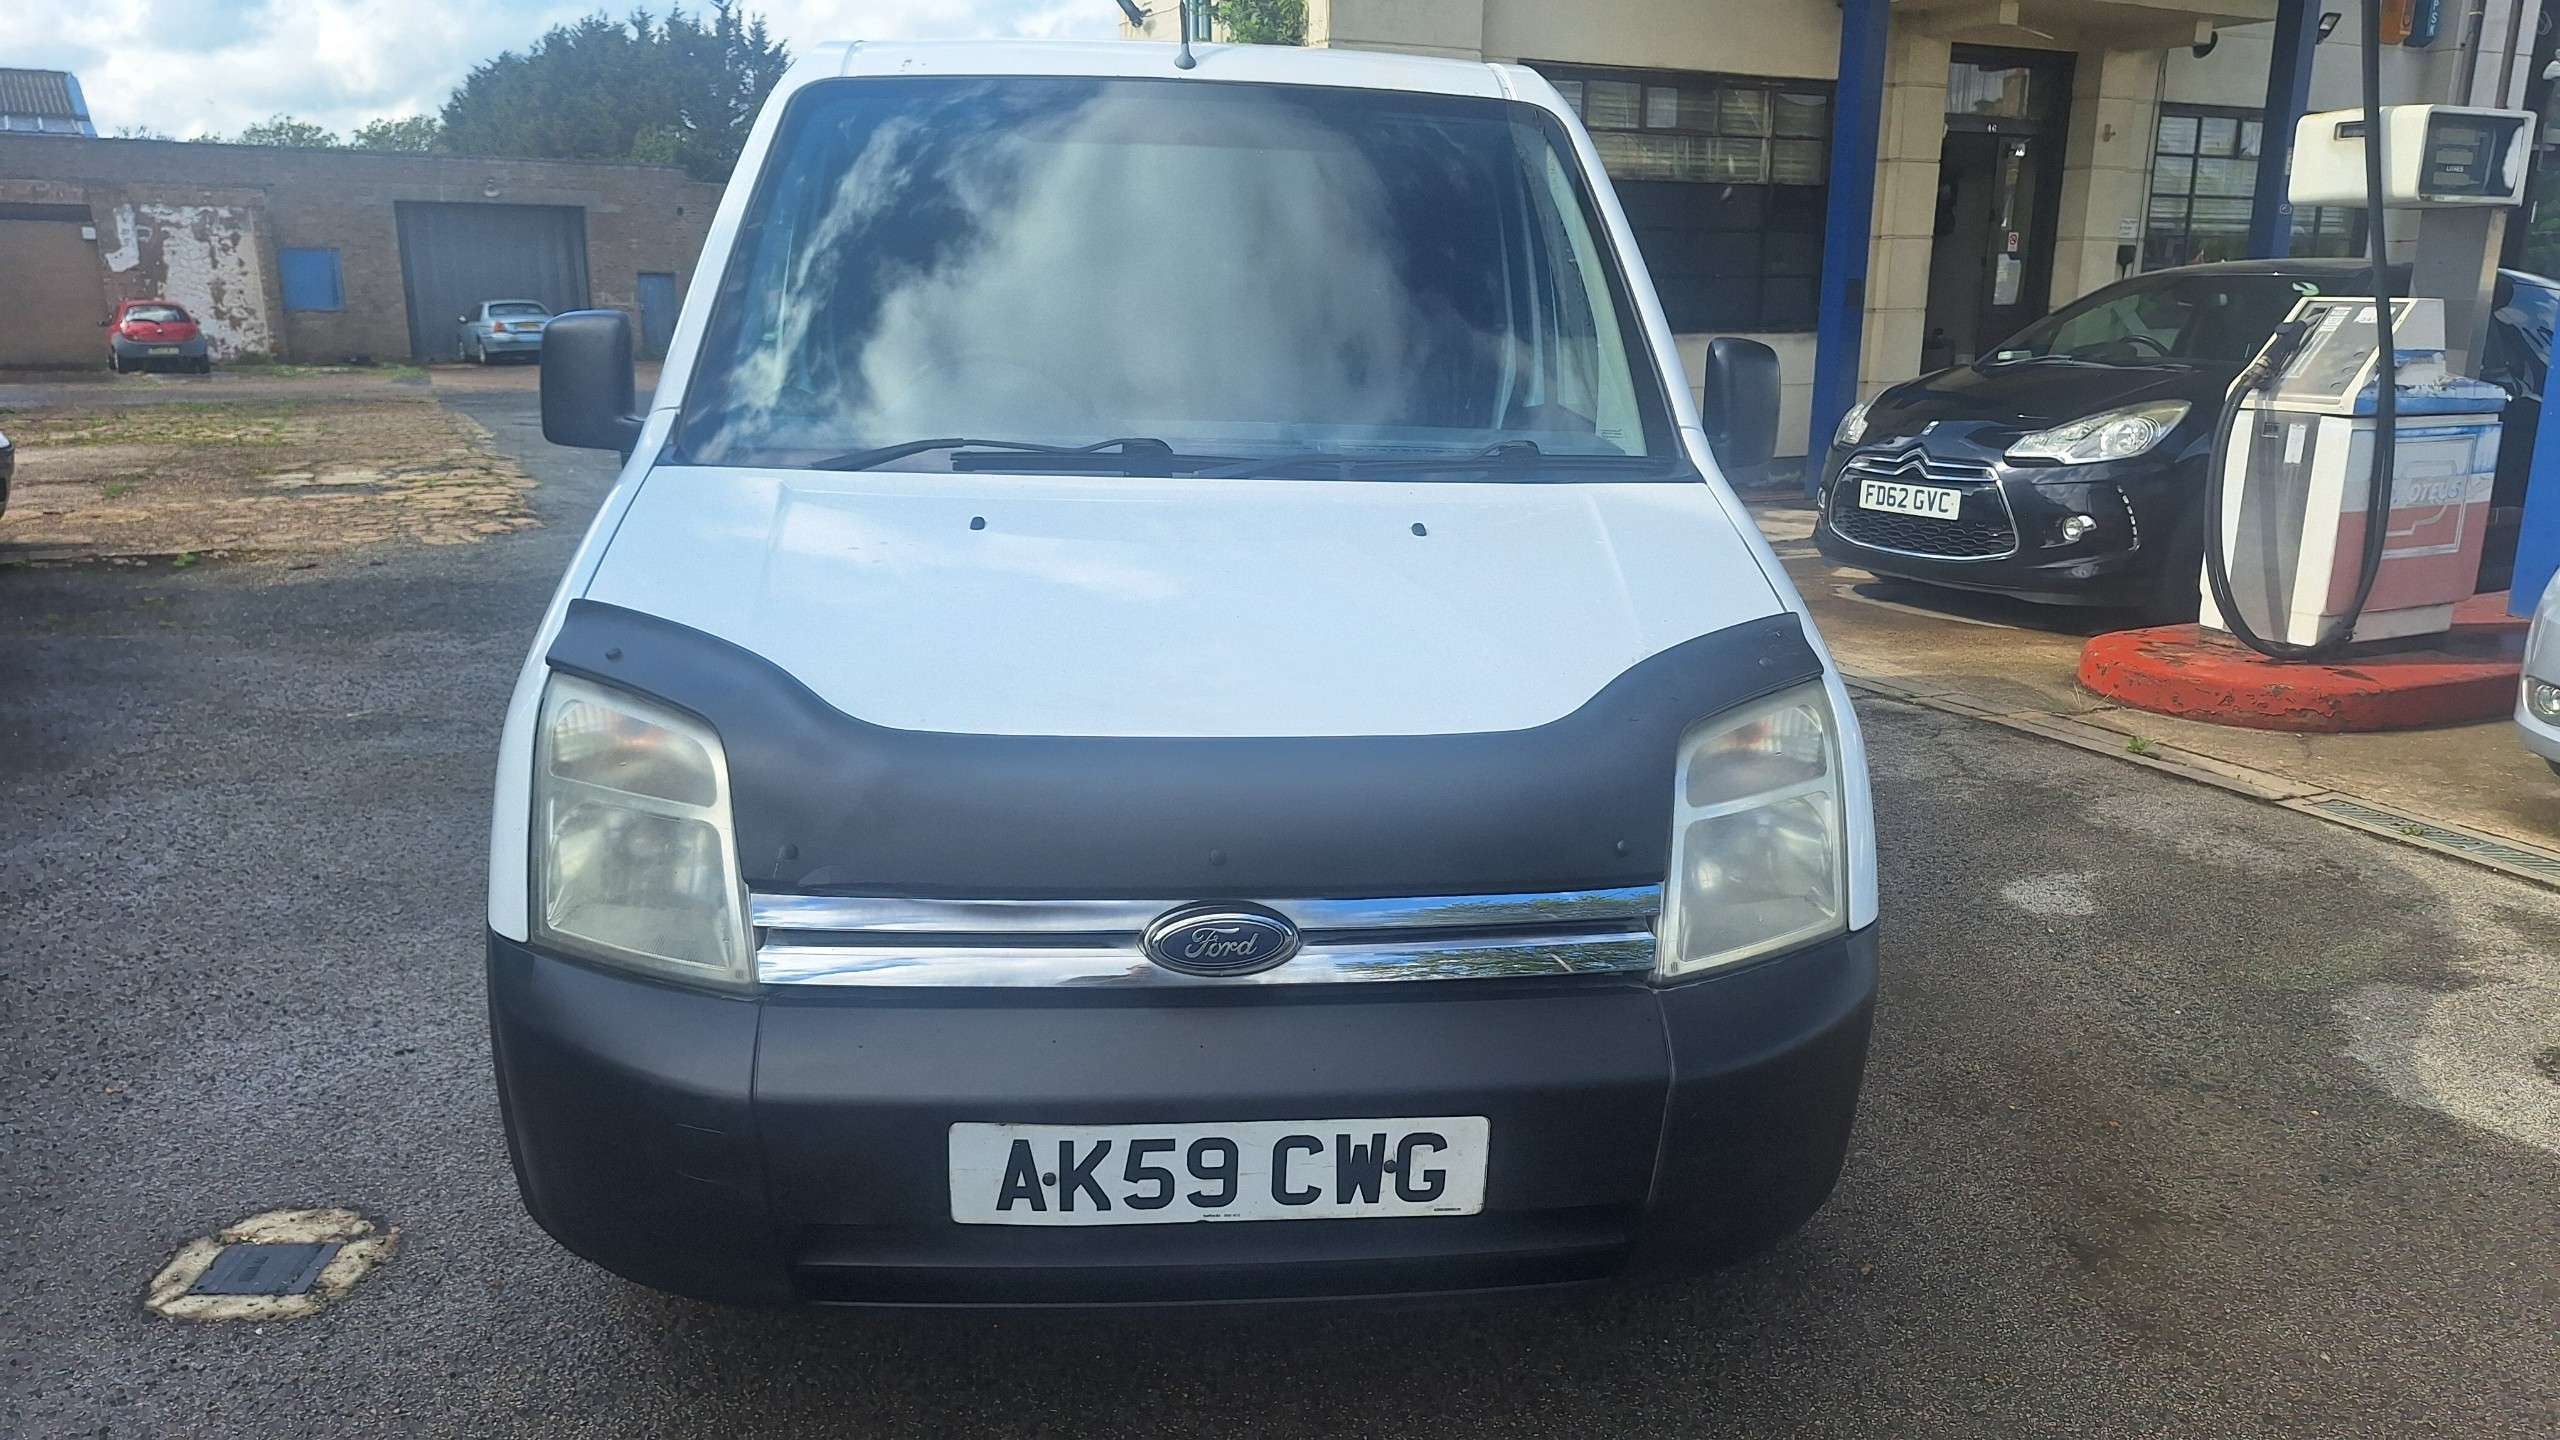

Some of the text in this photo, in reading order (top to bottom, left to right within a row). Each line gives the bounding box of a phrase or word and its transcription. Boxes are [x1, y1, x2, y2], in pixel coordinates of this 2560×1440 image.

[1865, 484, 1951, 513] FD62 GVC
[1184, 927, 1259, 959] Ford
[996, 1132, 1448, 1212] AK59 CWG
